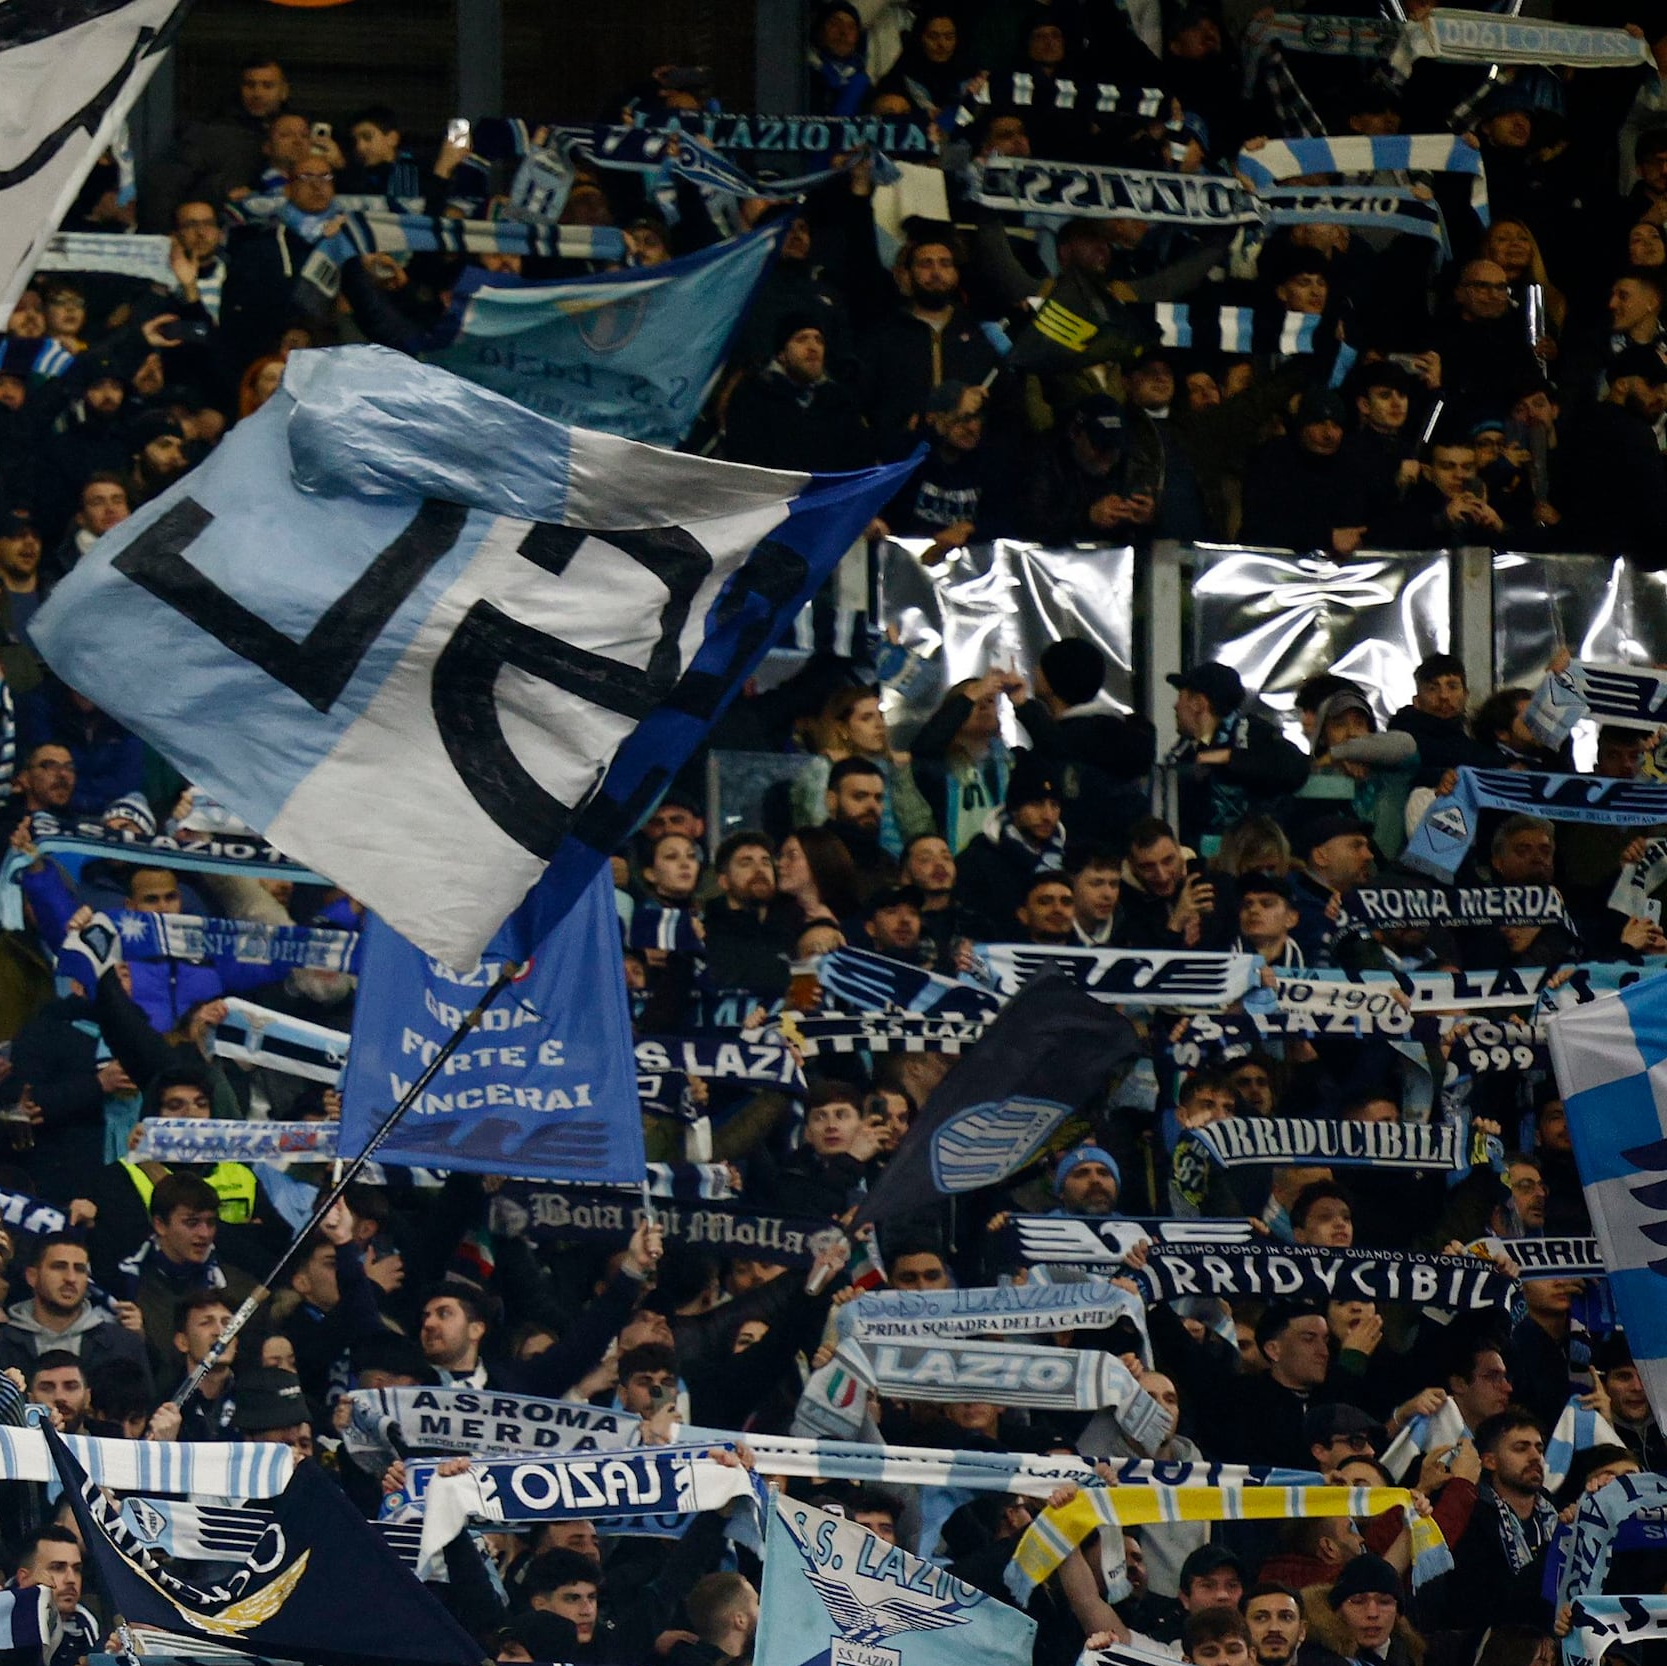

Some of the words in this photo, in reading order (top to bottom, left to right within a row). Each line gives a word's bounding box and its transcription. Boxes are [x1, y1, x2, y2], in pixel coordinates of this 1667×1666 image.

[1357, 886, 1451, 922] ROMA
[1457, 884, 1566, 921] MERDA
[1255, 1005, 1413, 1039] LAZIO
[1207, 1117, 1456, 1161] IRRIDUCIBILI
[866, 1320, 918, 1339] PRIMA
[922, 1317, 998, 1336] SQUADRA
[1001, 1315, 1056, 1332] DELLA
[875, 1352, 1072, 1390] LAZIO
[419, 1414, 598, 1452] MERDA
[855, 1532, 991, 1602] LAZIO
